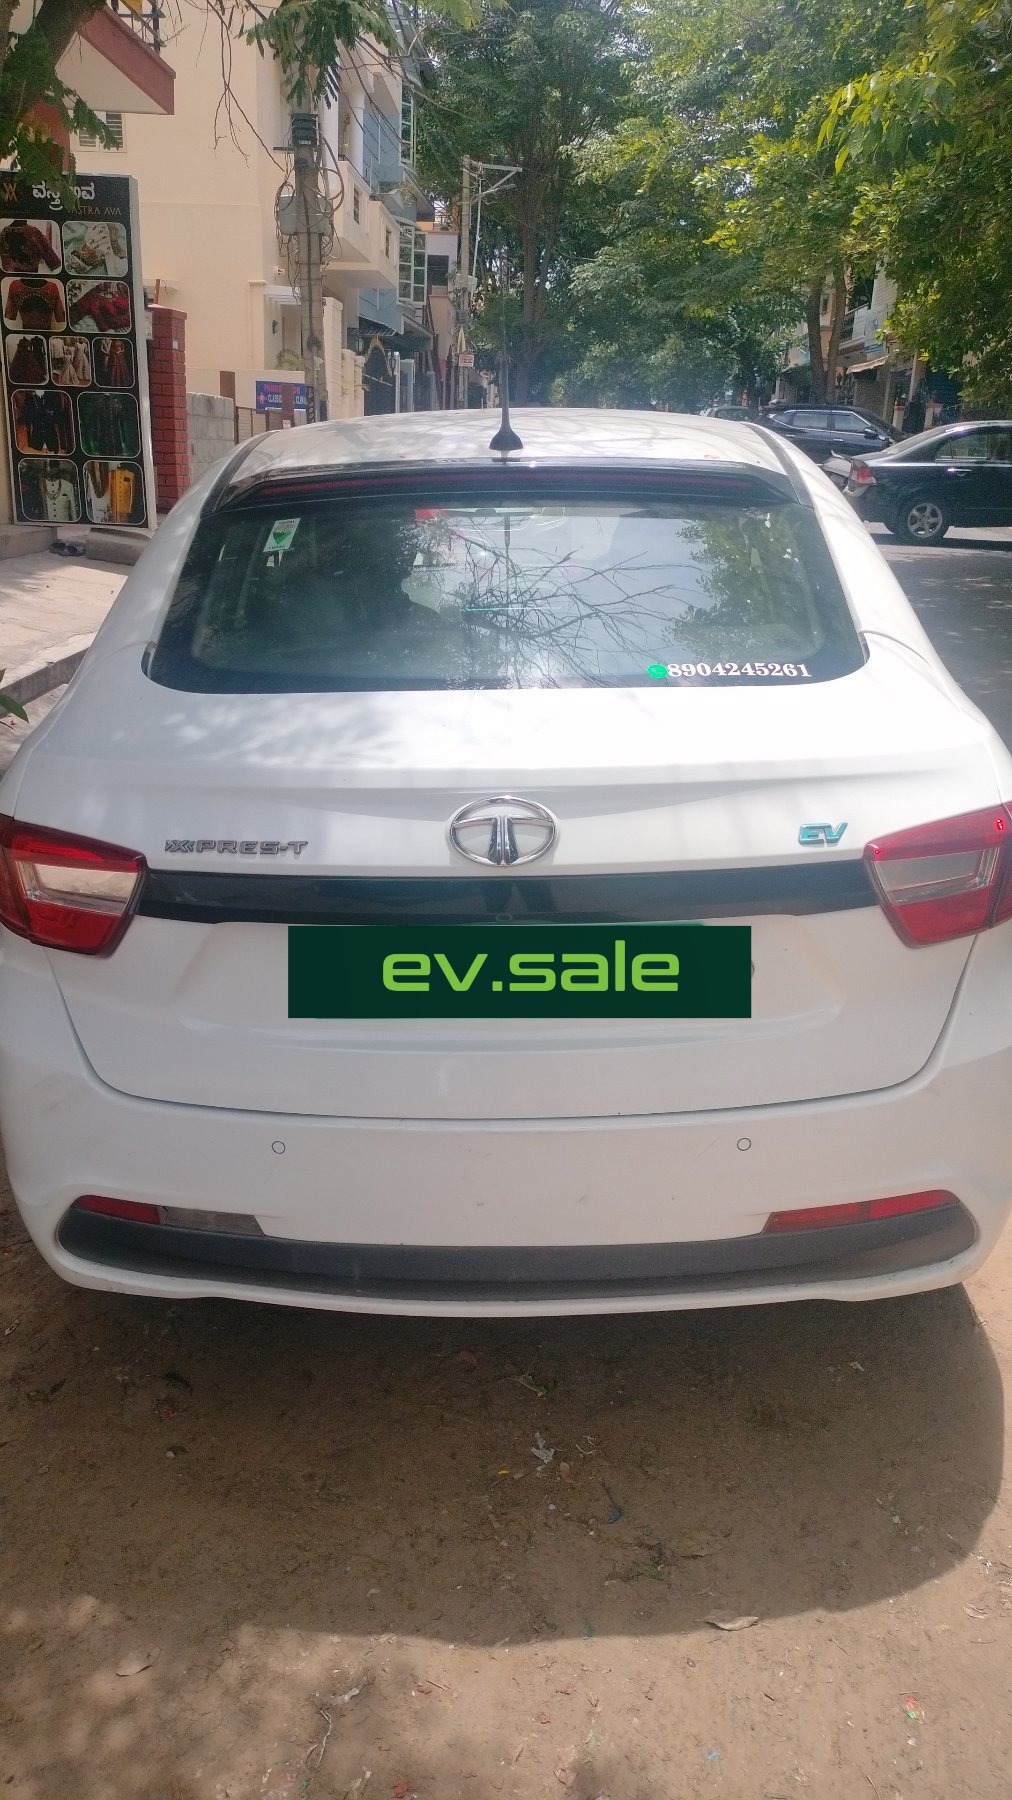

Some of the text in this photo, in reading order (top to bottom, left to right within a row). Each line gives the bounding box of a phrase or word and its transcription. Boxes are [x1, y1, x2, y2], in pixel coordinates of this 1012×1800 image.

[104, 207, 122, 216] AVA
[667, 662, 812, 678] 8904245261
[799, 822, 848, 845] EV
[165, 839, 309, 855] XPRES-T
